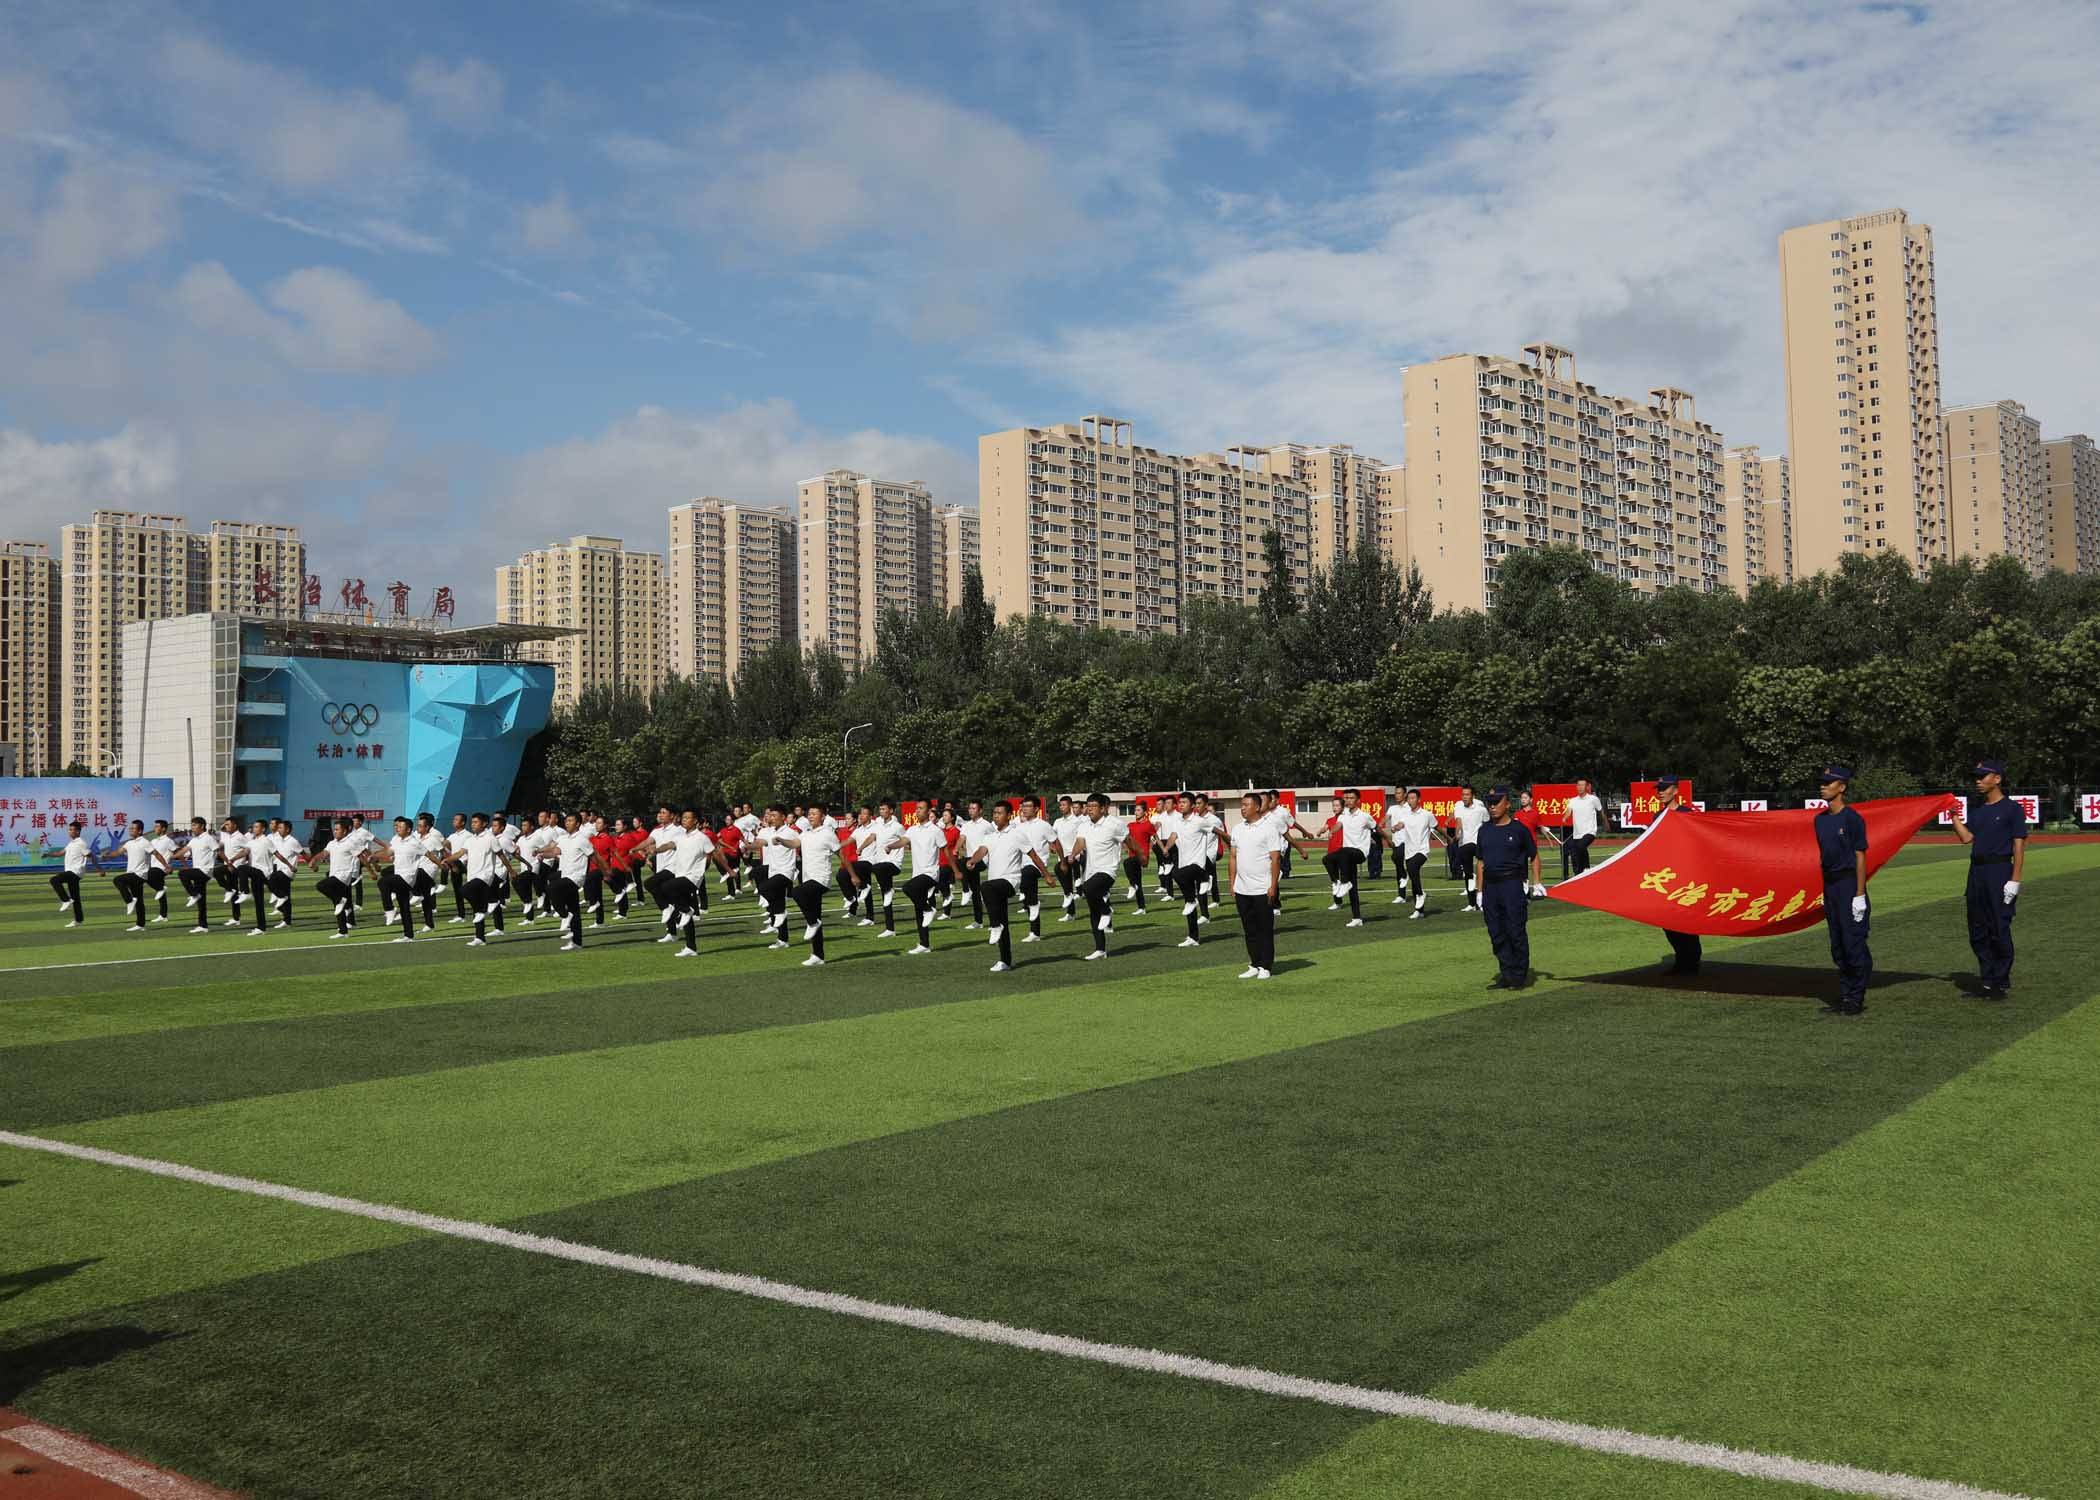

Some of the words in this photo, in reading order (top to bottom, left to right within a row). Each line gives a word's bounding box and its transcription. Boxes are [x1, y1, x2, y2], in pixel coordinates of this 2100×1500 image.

[48, 799, 98, 810] 文明长治
[1640, 867, 1824, 922] 长治市应急
